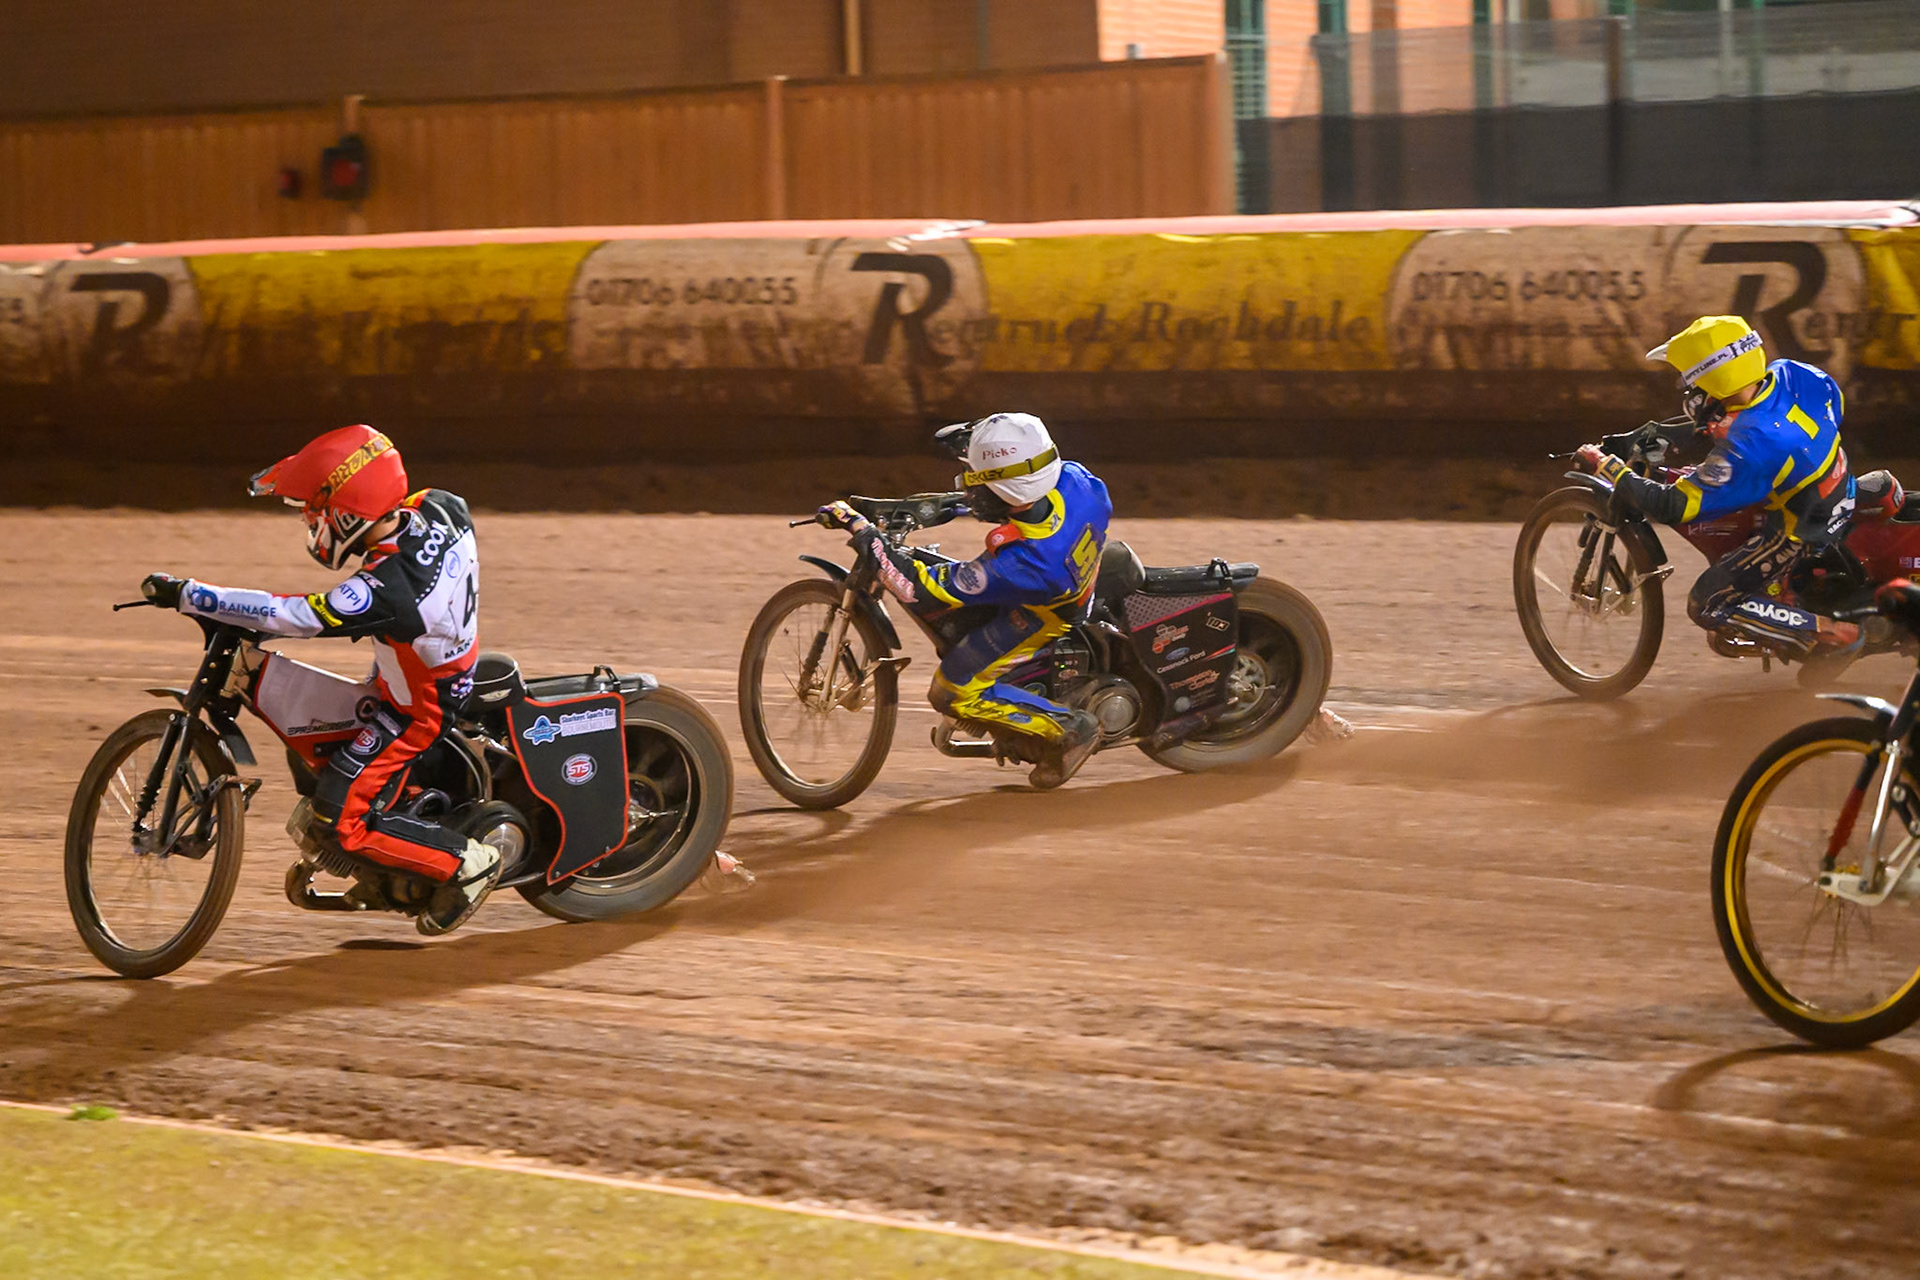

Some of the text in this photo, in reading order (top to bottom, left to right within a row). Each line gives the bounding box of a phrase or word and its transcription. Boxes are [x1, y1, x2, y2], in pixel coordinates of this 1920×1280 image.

[1786, 404, 1820, 440] 1
[416, 520, 449, 567] COOK
[1071, 529, 1098, 577] 5
[338, 583, 362, 607] ATPI
[444, 638, 473, 660] MAN
[568, 763, 590, 776] STS
